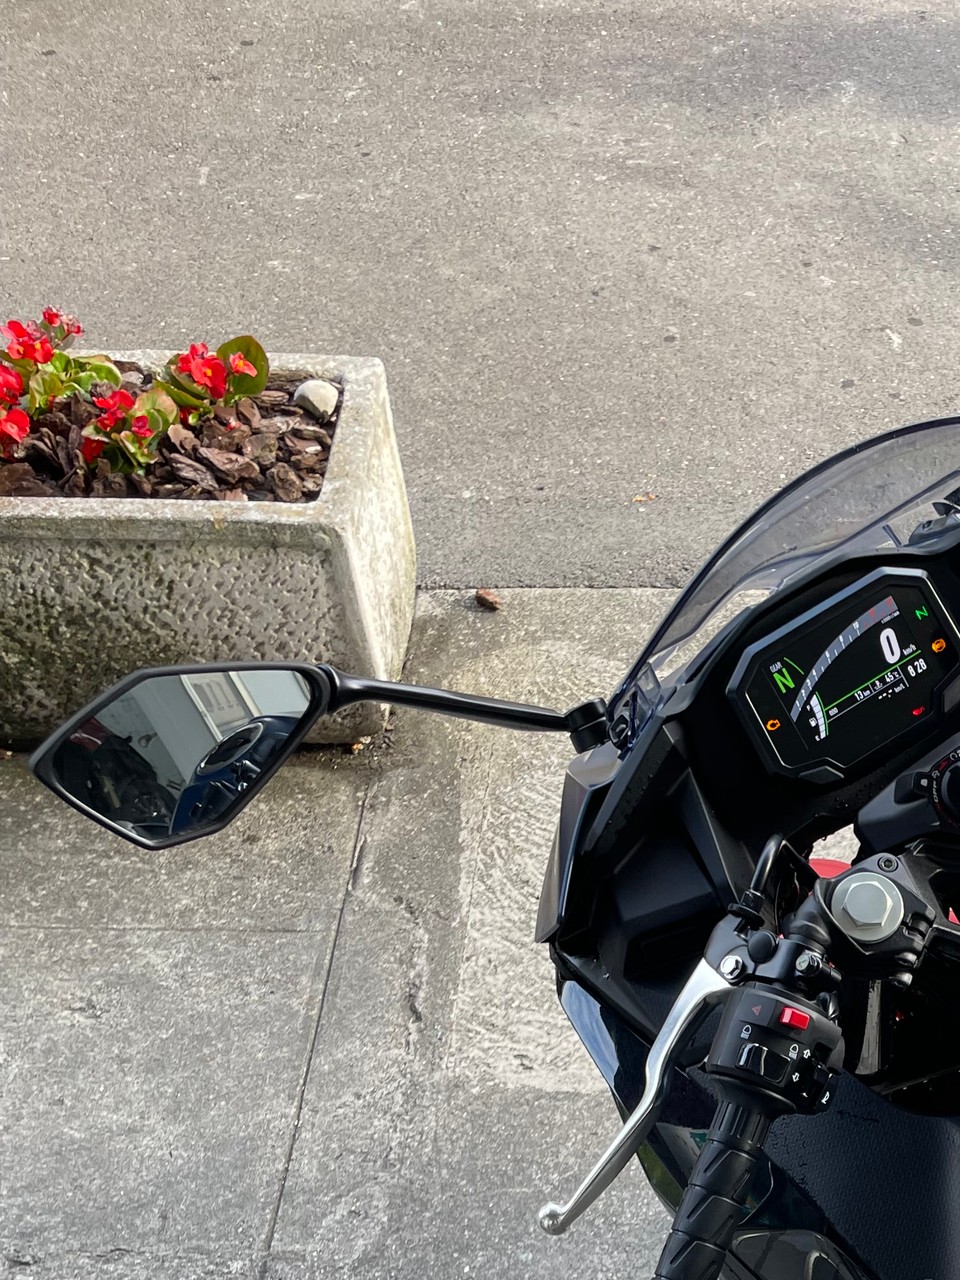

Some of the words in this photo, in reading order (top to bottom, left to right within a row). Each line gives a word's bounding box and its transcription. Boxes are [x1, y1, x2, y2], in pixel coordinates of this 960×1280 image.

[915, 606, 928, 620] N
[880, 627, 900, 664] 0
[773, 667, 795, 694] N
[884, 671, 894, 683] 45
[854, 690, 864, 701] 13
